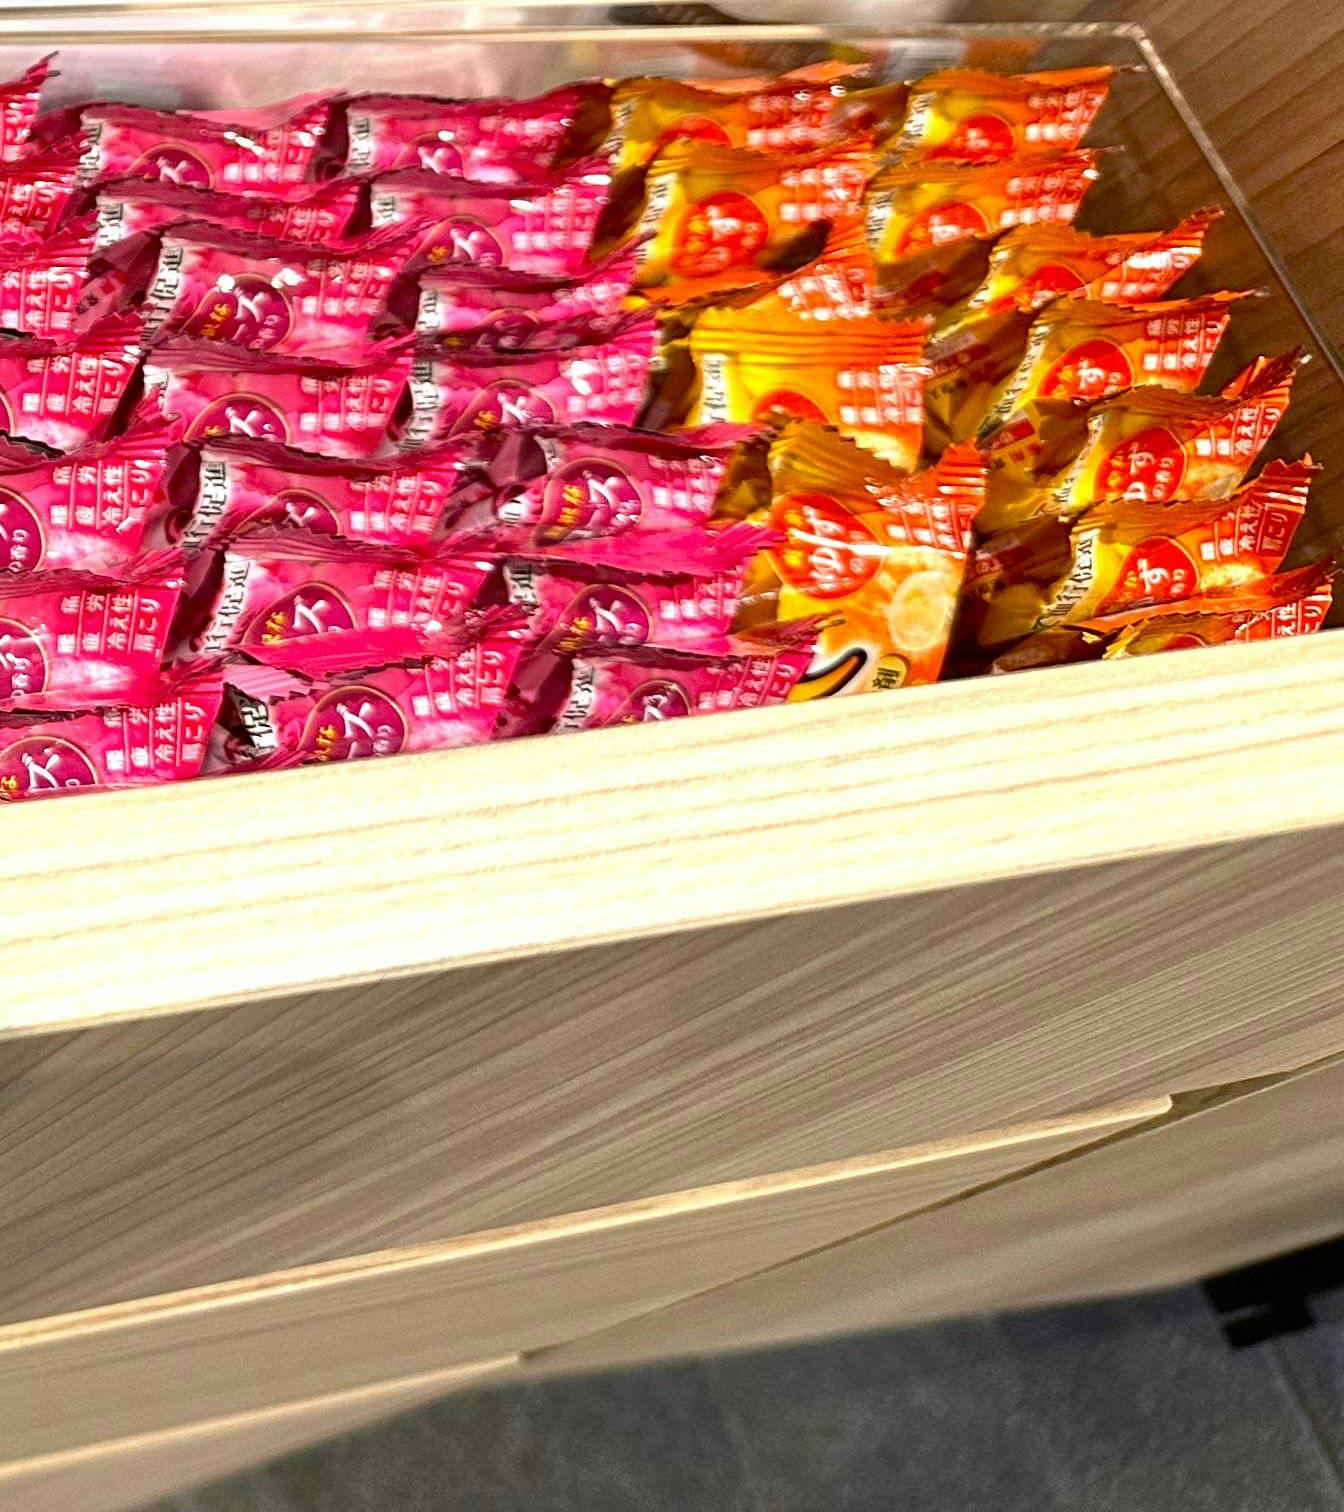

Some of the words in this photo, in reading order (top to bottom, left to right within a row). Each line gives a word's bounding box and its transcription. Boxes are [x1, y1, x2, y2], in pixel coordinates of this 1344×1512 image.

[72, 357, 96, 415] 冷え性
[102, 465, 124, 525] 冷え性
[108, 594, 132, 650] 冷え性
[155, 702, 177, 764] 冷え性
